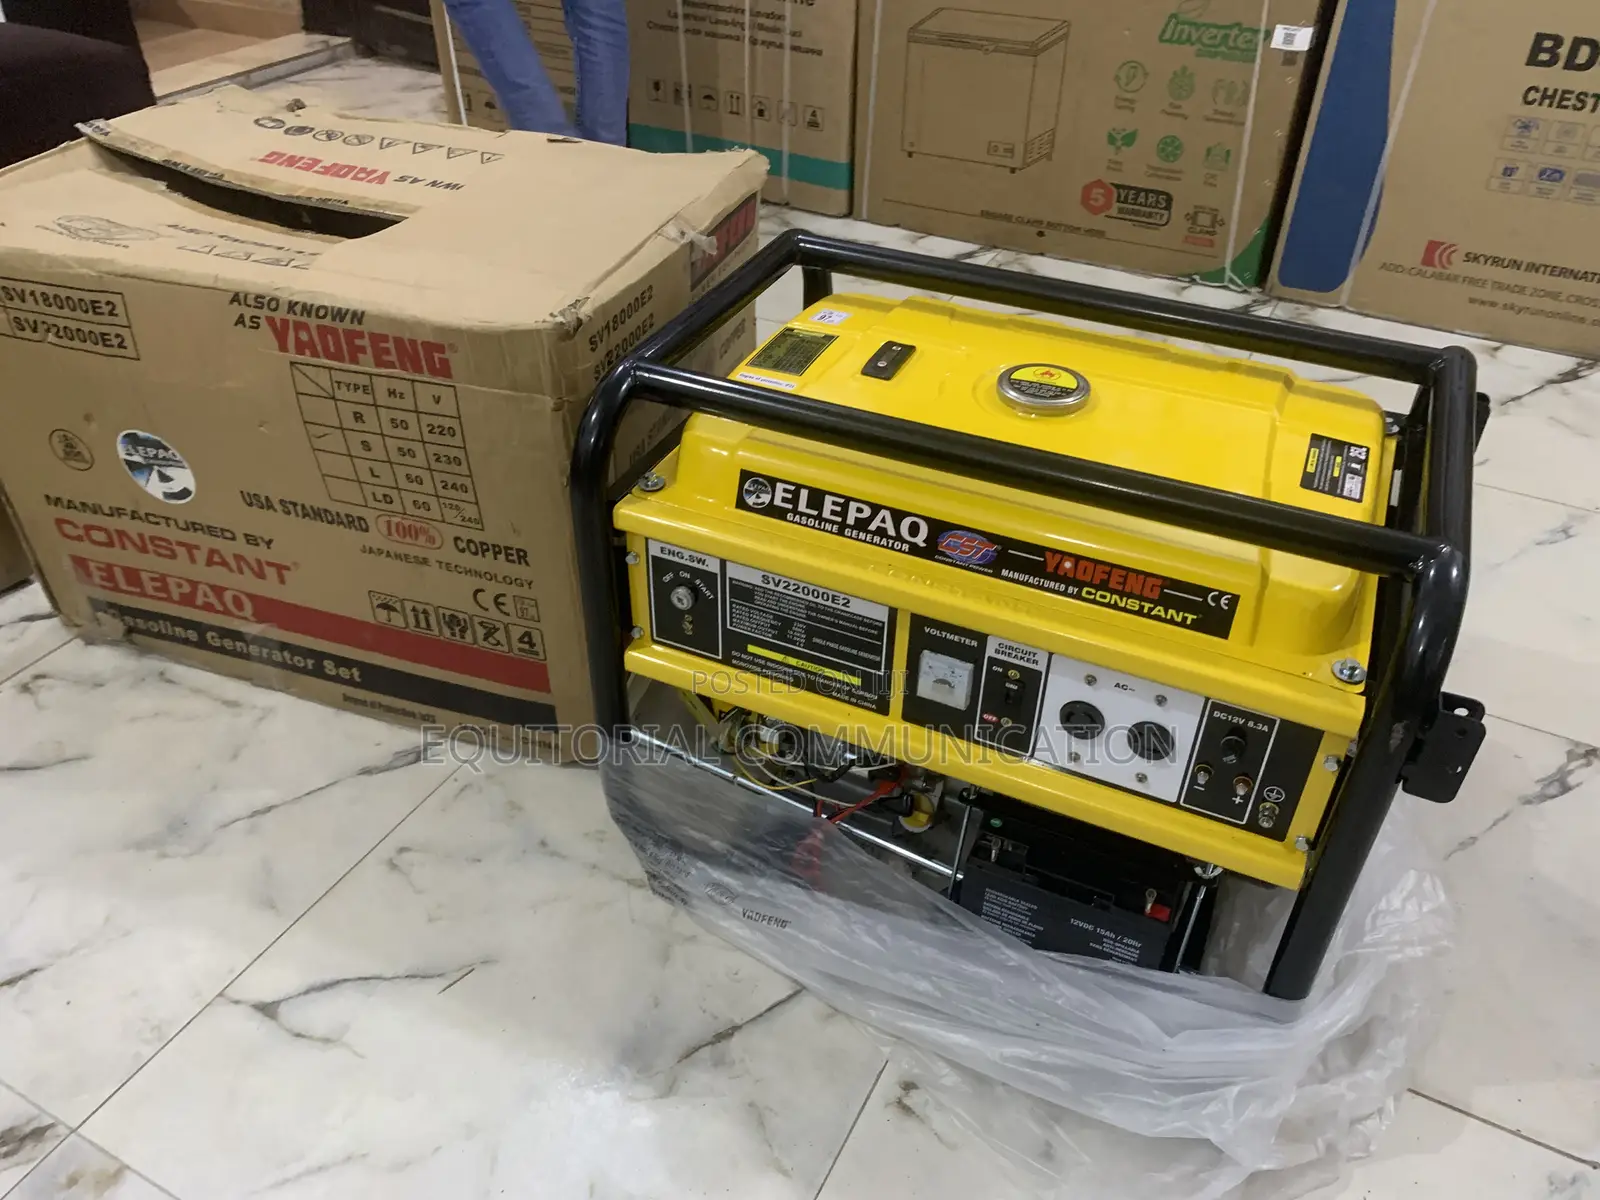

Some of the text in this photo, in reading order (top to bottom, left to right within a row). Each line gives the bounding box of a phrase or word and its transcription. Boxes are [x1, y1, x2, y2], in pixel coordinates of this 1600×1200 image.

[258, 150, 392, 185] YAOFENG
[1089, 188, 1168, 209] 5 YEARS
[1463, 252, 1524, 271] SKYRUN
[0, 285, 120, 317] SV18000E2
[1461, 276, 1489, 289] FREE
[1491, 280, 1527, 296] TRADE
[229, 292, 366, 326] ALSO KNOWN
[588, 284, 654, 353] SV18000E2
[12, 316, 129, 350] SV22000E2
[233, 313, 453, 380] AS YAOFENG
[335, 380, 442, 406] TYPE Hz V
[353, 411, 457, 439] R 50 220
[360, 440, 463, 467] S 50 230
[369, 466, 381, 479] L
[440, 480, 469, 495] 240
[372, 492, 394, 506] LD
[44, 494, 275, 550] MANUFACTURED BY
[239, 490, 531, 567] USA STANDARD 100% COPPER
[773, 481, 930, 548] ELEPAQ
[786, 512, 910, 553] GASOLINE GENERATOR
[54, 517, 292, 586] CONSTANT
[660, 546, 710, 568] ENG.SW.
[360, 544, 534, 590] JAPANESE TECHNOLOGY
[1044, 550, 1165, 600] YAOFENG
[87, 559, 257, 622] ELEPAQ
[662, 570, 715, 600] OFF ON START
[761, 574, 851, 609] SV22000E2
[1000, 568, 1198, 626] MANUFACTURED BY CONSTANT
[472, 588, 511, 617] CE
[1207, 591, 1233, 611] CE
[924, 626, 978, 648] VOLTMETER
[998, 642, 1038, 659] CIRCUIT
[205, 631, 316, 671] Generator
[323, 658, 362, 683] Set
[992, 665, 1003, 673] ON
[994, 648, 1039, 667] BREAKER
[832, 691, 849, 701] MADE
[857, 699, 877, 710] CHINA
[982, 713, 998, 721] OFF
[1212, 710, 1269, 733] DC12V 8.3A
[1070, 917, 1095, 931] 12VDC
[1096, 927, 1116, 939] 15Ah
[1122, 936, 1142, 948] 20Hr
